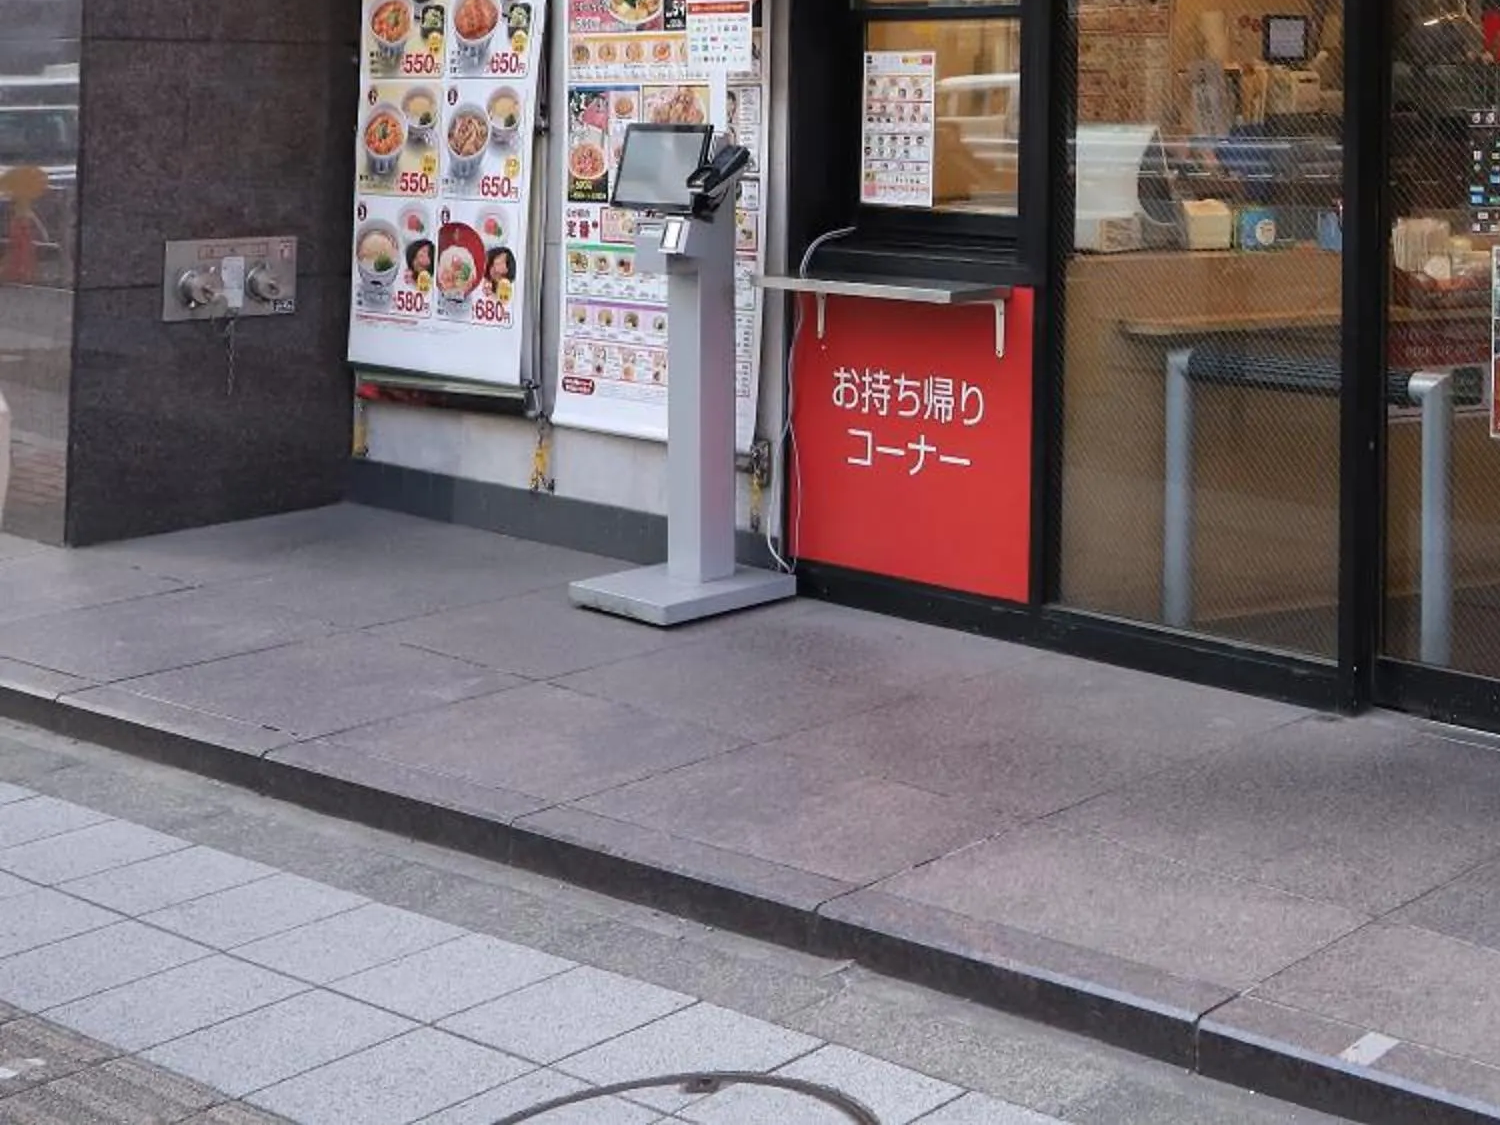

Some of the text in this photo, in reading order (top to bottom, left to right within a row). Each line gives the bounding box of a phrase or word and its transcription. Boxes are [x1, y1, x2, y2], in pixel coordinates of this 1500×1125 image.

[832, 367, 985, 425] お持ち帰り
[847, 428, 972, 476] コーナー
